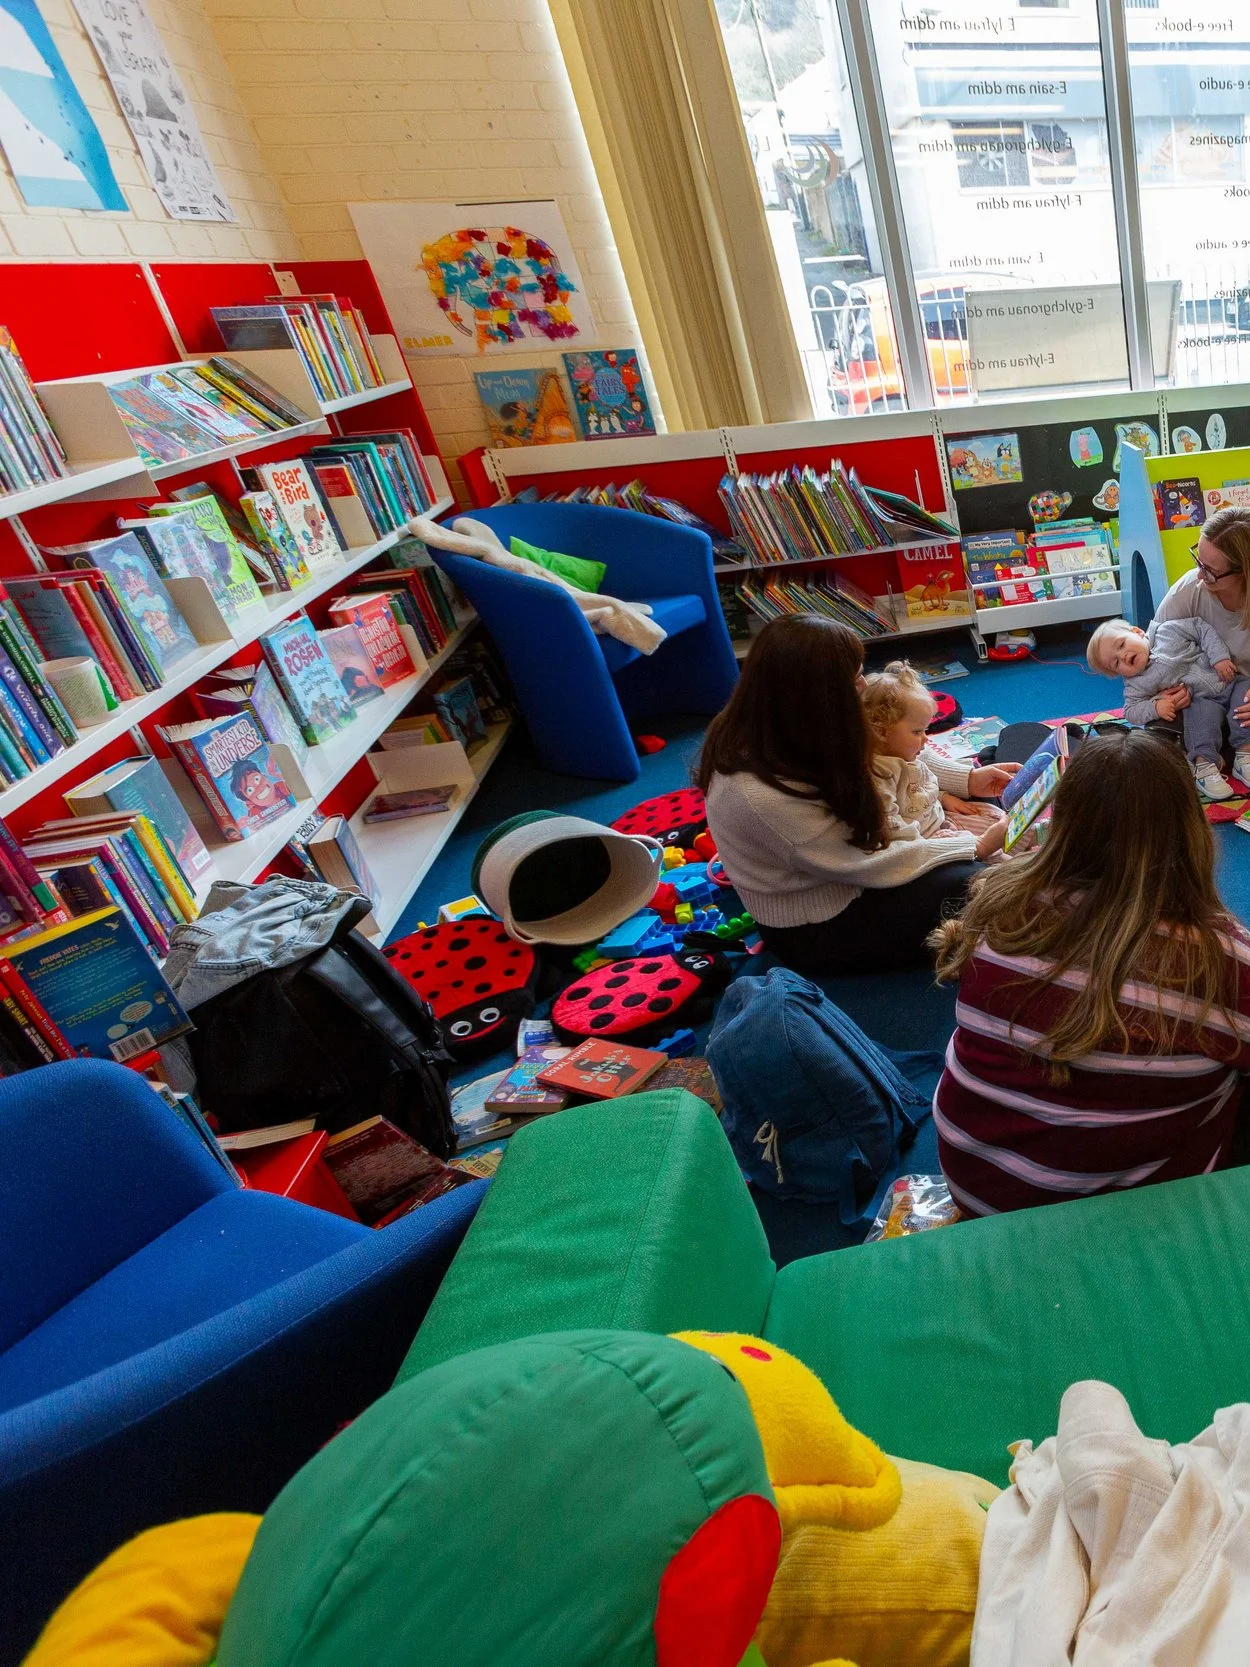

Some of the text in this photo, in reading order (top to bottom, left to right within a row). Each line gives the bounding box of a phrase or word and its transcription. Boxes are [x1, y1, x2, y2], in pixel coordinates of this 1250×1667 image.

[403, 335, 454, 349] ELMER
[272, 467, 301, 489] Bear
[285, 483, 310, 505] Bird
[904, 545, 953, 561] CAMEL
[284, 643, 324, 677] ROSEN
[14, 684, 39, 719] Wizards
[205, 729, 238, 760] SMARTEST
[238, 720, 250, 737] KID
[217, 730, 261, 771] UNIVERSE
[544, 1040, 597, 1078] CORAL RUMBLE
[597, 1054, 632, 1083] Otter
